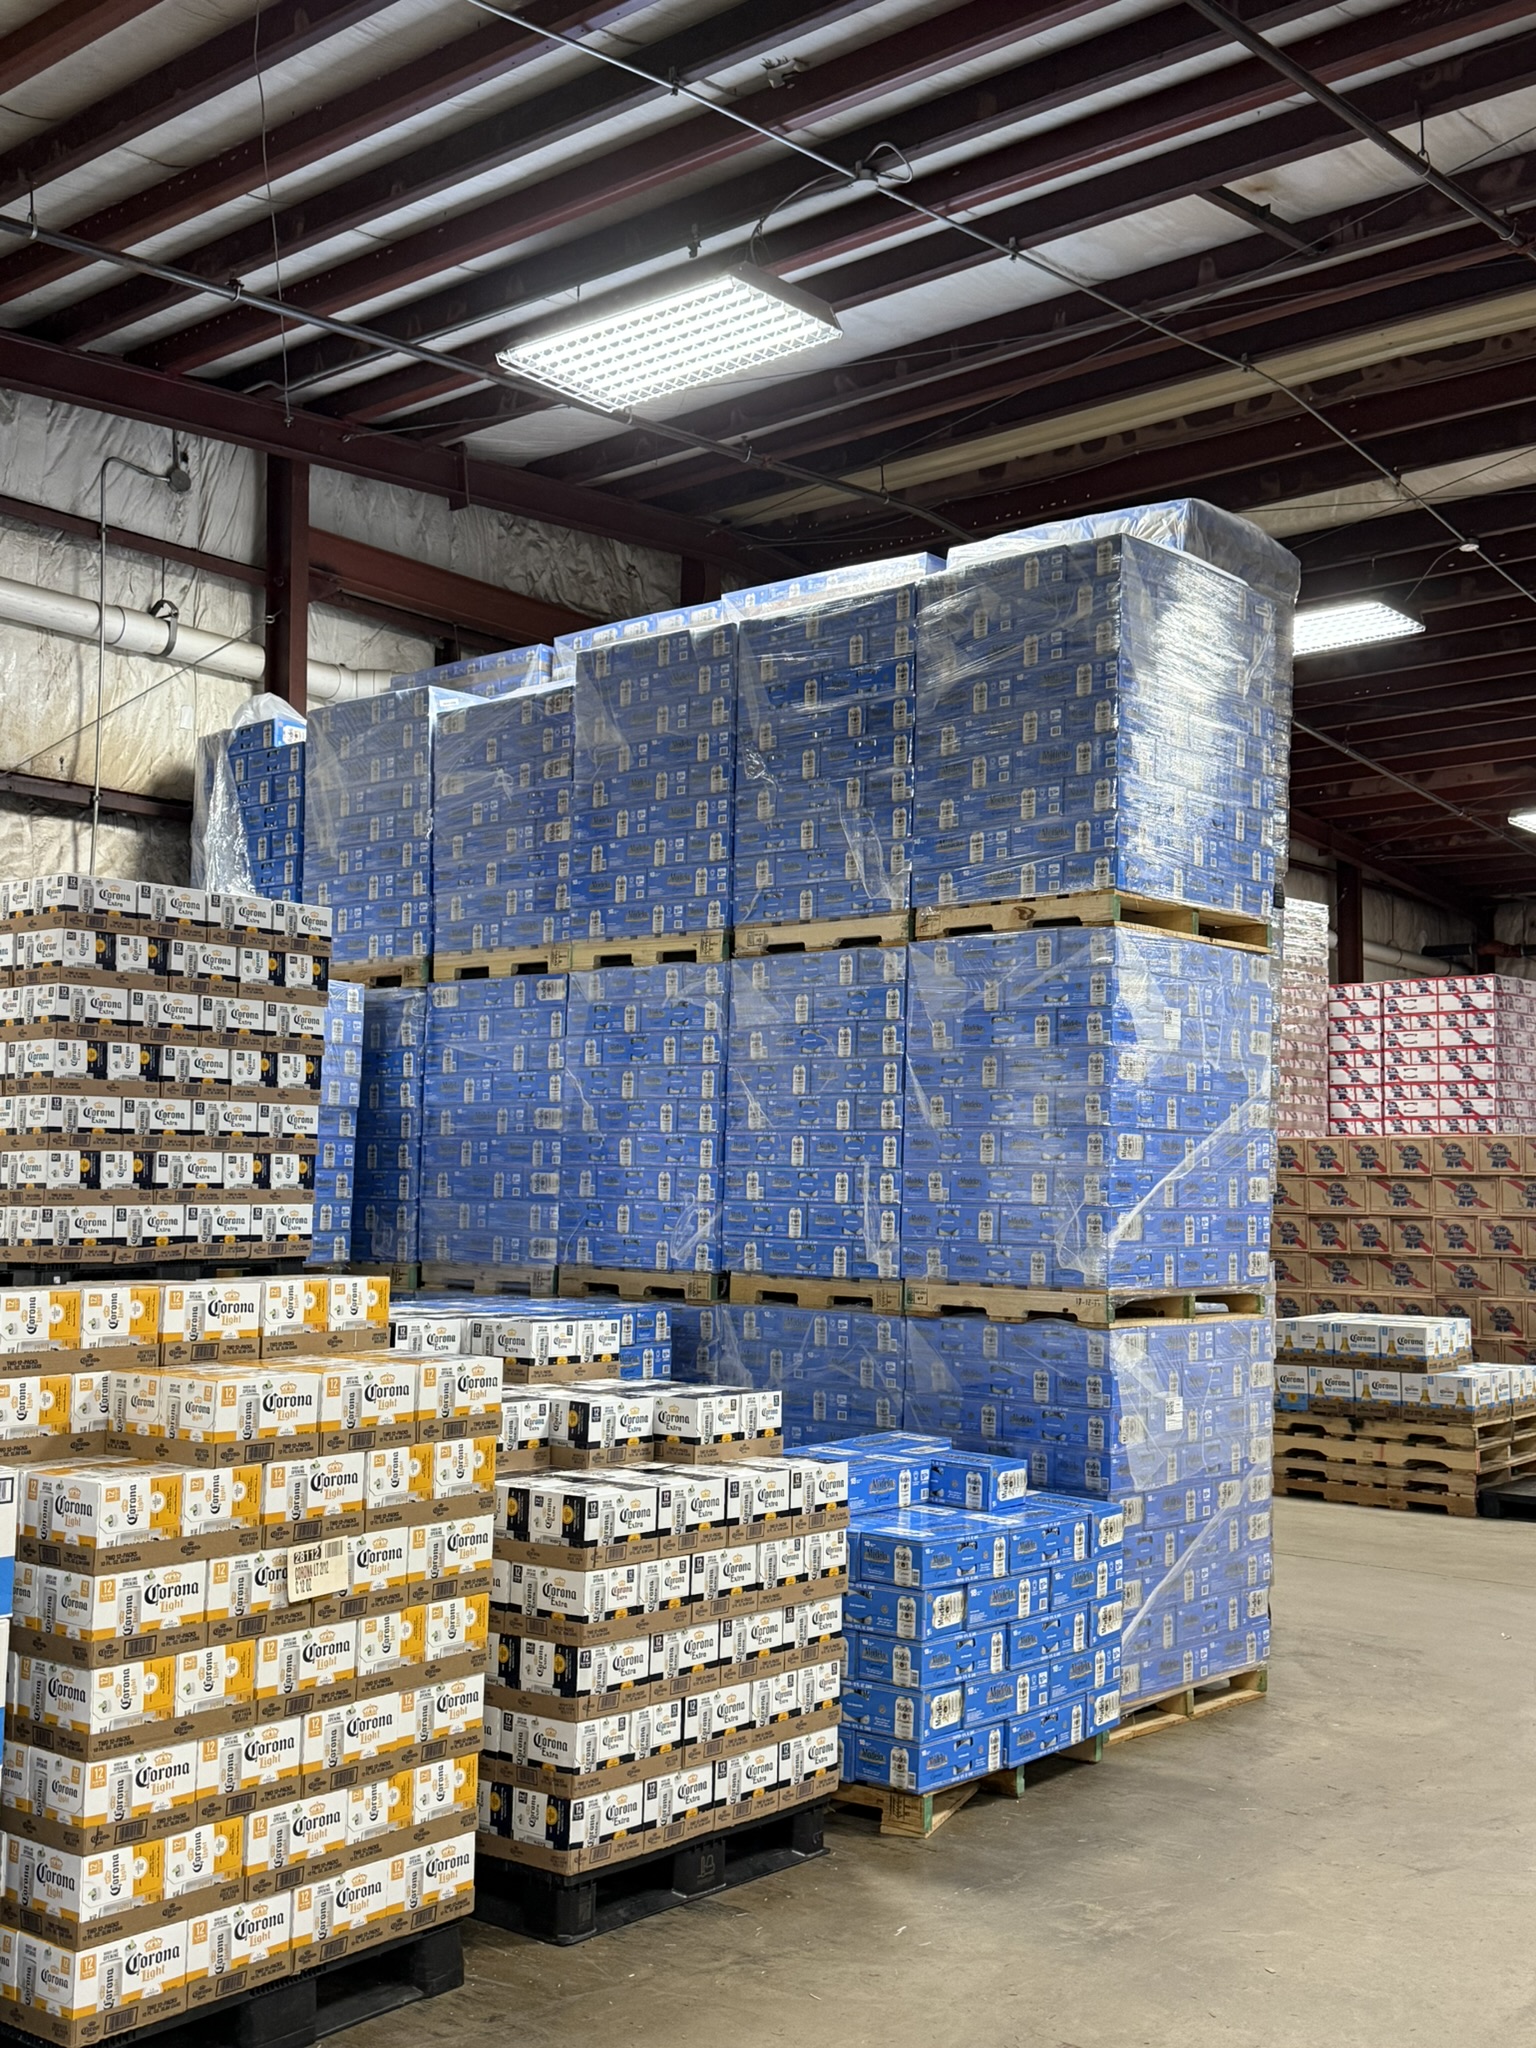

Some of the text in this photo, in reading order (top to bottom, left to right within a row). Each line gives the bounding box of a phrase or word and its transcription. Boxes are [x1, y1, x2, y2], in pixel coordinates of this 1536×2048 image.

[99, 888, 131, 902] Corona
[170, 896, 201, 910] Corona
[301, 915, 329, 928] Corona
[202, 954, 232, 967] Corona
[90, 998, 122, 1010] Corona
[194, 1057, 224, 1070] Corona
[83, 1107, 116, 1120] Corona
[187, 1163, 217, 1175] Corona
[74, 1214, 107, 1229] Corona
[280, 1215, 308, 1226] Corona
[171, 1292, 182, 1303] 12
[26, 1296, 37, 1335] Corona
[108, 1292, 119, 1330] Corona
[207, 1299, 255, 1319] Corona
[221, 1314, 242, 1326] Light
[427, 1332, 456, 1346] Corona
[1350, 1334, 1375, 1343] Corona
[1397, 1336, 1423, 1345] Corona
[458, 1375, 498, 1392] Corona
[1280, 1375, 1304, 1383] Corona
[1325, 1378, 1350, 1387] Corona
[1371, 1381, 1398, 1390] Corona
[364, 1383, 409, 1402] Corona
[470, 1389, 487, 1400] Light
[185, 1401, 210, 1416] Corona
[262, 1392, 312, 1413] Corona
[277, 1409, 298, 1421] Light
[619, 1413, 649, 1428] Corona
[658, 1413, 690, 1428] Corona
[666, 1423, 682, 1432] Extra
[274, 1470, 283, 1480] 12
[391, 1451, 399, 1488] Corona
[310, 1471, 358, 1493] Corona
[818, 1477, 845, 1494] Corona
[292, 1482, 301, 1520] Corona
[324, 1487, 345, 1499] Light
[757, 1487, 786, 1504] Corona
[55, 1494, 93, 1518] Corona
[127, 1484, 137, 1526] Corona
[690, 1496, 720, 1514] Corona
[65, 1516, 81, 1528] Light
[619, 1506, 652, 1524] Corona
[697, 1509, 713, 1519] Extra
[627, 1519, 644, 1530] Extra
[447, 1532, 488, 1551] Corona
[295, 1548, 319, 1563] 28112
[357, 1547, 402, 1568] Corona
[216, 1564, 226, 1575] 12
[255, 1565, 287, 1586] Coro
[103, 1582, 113, 1593] 12
[144, 1582, 199, 1606] Corona
[542, 1583, 577, 1601] Corona
[61, 1594, 87, 1611] Corona
[160, 1600, 184, 1613] Light
[550, 1597, 568, 1608] Extra
[123, 1595, 133, 1636] Corona
[812, 1610, 839, 1627] Corona
[303, 1640, 350, 1663] Corona
[204, 1651, 213, 1692] Corona
[612, 1653, 644, 1674] Corona
[620, 1666, 637, 1677] Extra
[48, 1677, 86, 1702] Corona
[121, 1668, 130, 1709] Corona
[57, 1700, 74, 1712] Light
[717, 1701, 746, 1720] Corona
[245, 1736, 294, 1761] Corona
[534, 1734, 568, 1752] Corona
[542, 1747, 559, 1760] Extra
[808, 1743, 834, 1760] Corona
[259, 1755, 281, 1768] Light
[95, 1767, 104, 1779] 12
[136, 1762, 190, 1789] Corona
[152, 1780, 175, 1795] Light
[678, 1780, 708, 1800] Corona
[114, 1779, 124, 1821] Corona
[605, 1801, 638, 1823] Corona
[292, 1811, 341, 1837] Corona
[614, 1815, 630, 1826] Extra
[307, 1829, 328, 1843] Light
[425, 1852, 470, 1877] Corona
[37, 1862, 75, 1891] Corona
[110, 1853, 119, 1896] Corona
[300, 1891, 308, 1902] 12
[234, 1911, 284, 1941] Corona
[250, 1931, 271, 1947] Light
[84, 1957, 93, 1969] 12
[125, 1945, 180, 1976] Corona
[41, 1968, 68, 1989] Corona
[141, 1966, 165, 1982] Light
[103, 1968, 114, 2011] Corona
